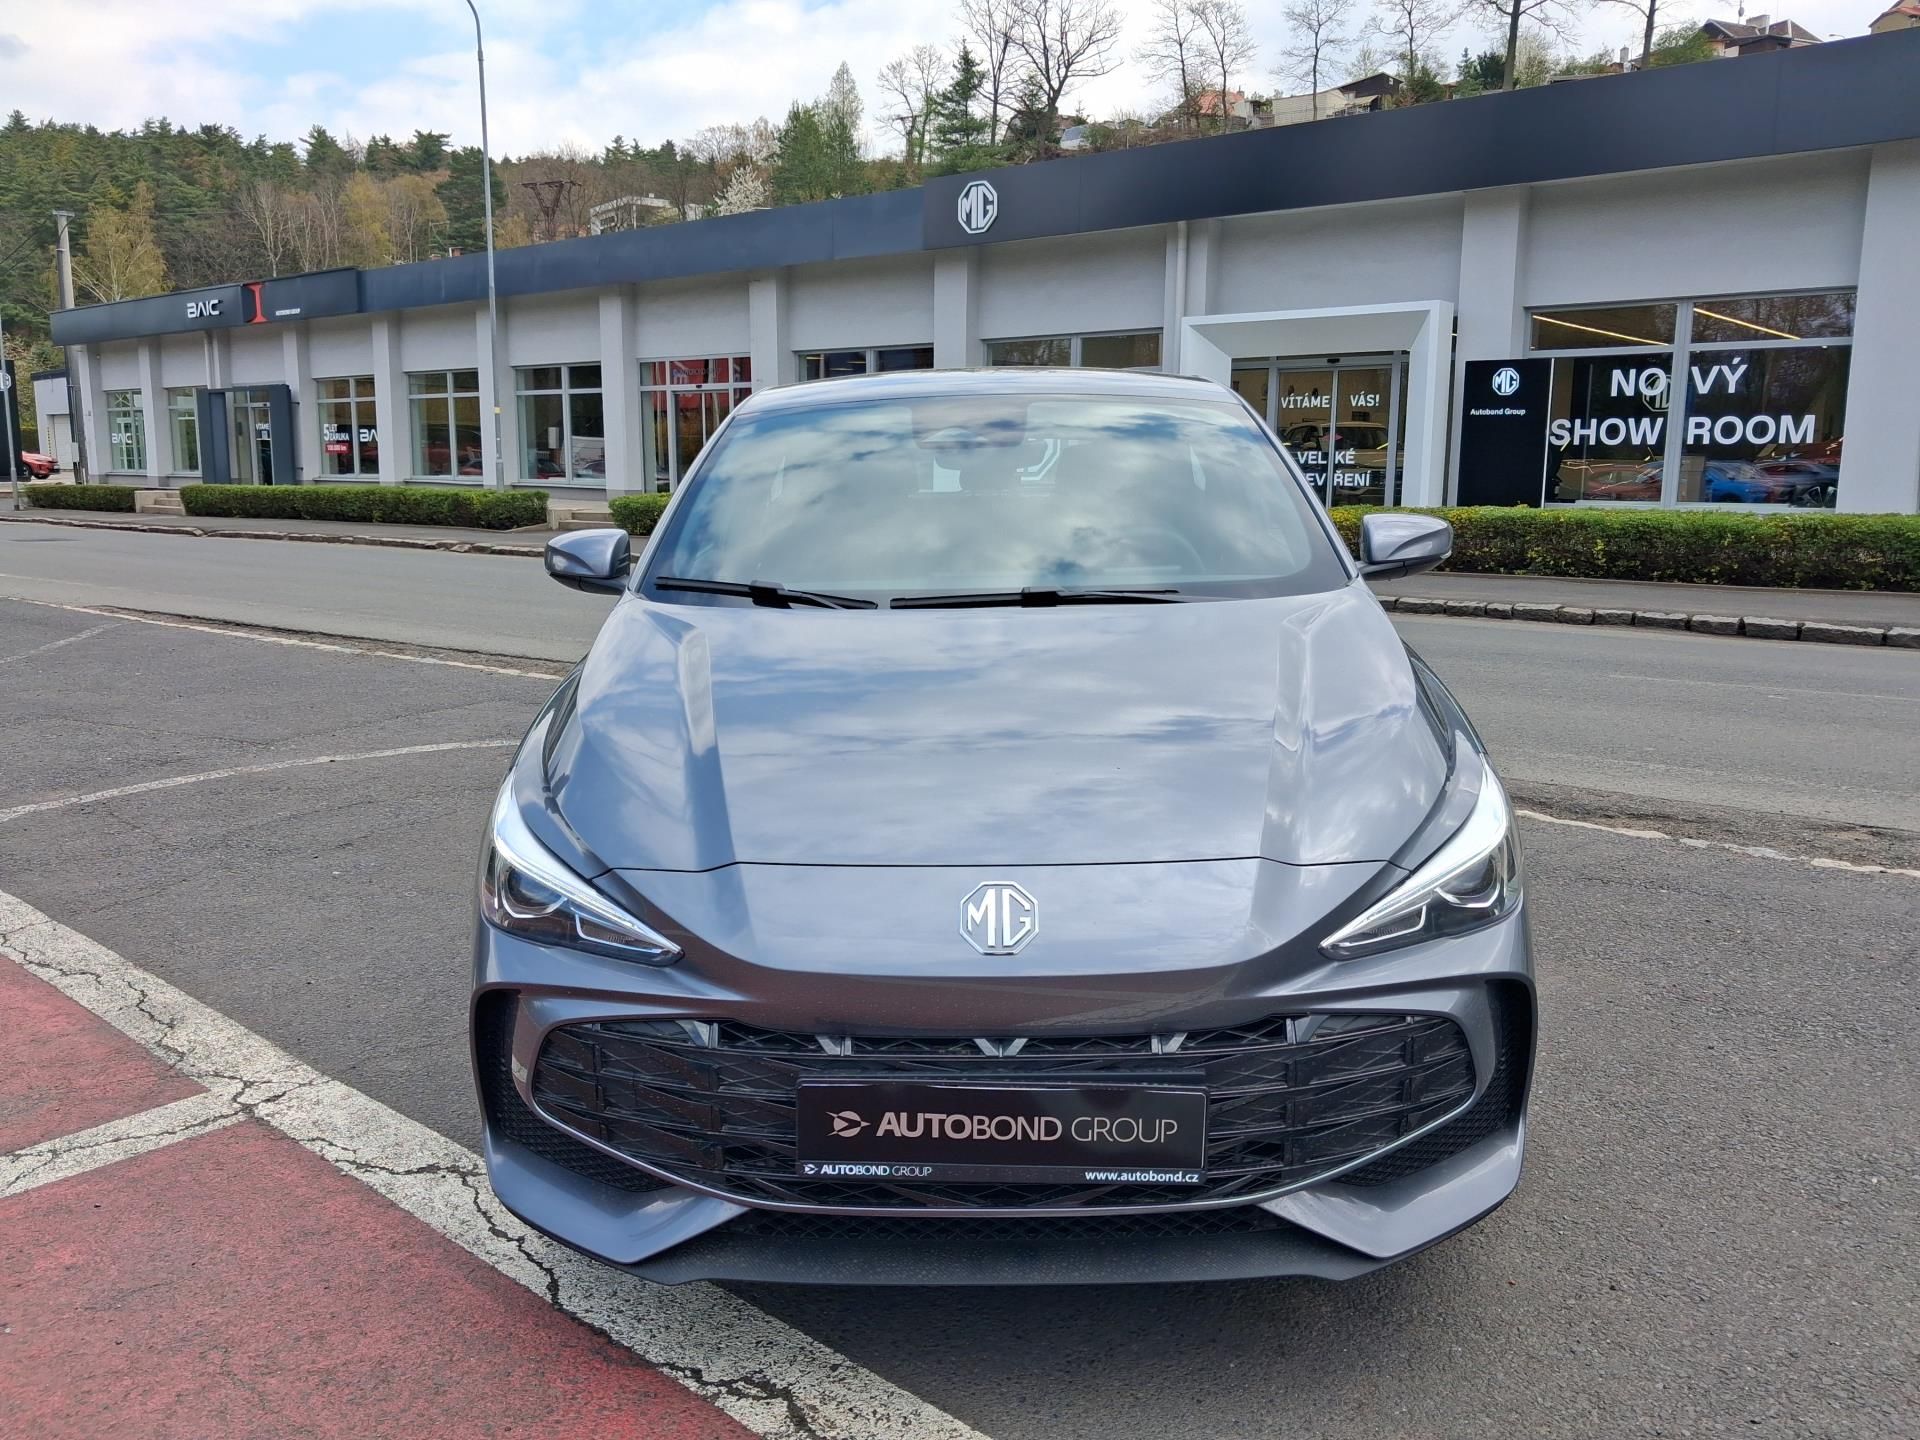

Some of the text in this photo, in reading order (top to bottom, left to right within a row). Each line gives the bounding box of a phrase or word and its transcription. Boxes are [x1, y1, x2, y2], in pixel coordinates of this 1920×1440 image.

[961, 185, 994, 229] MG
[186, 299, 220, 319] BAIC
[1494, 369, 1518, 394] MG
[1281, 391, 1380, 409] VÍTÁME VÁS!
[1504, 408, 1526, 416] Group
[323, 424, 330, 441] 5
[359, 428, 379, 442] BA
[967, 888, 1032, 948] MG
[875, 1111, 1178, 1143] AUTOBOND GROUP
[820, 1164, 933, 1177] AUTOBOND GROUP
[1085, 1171, 1199, 1183] www.autobond.cz
